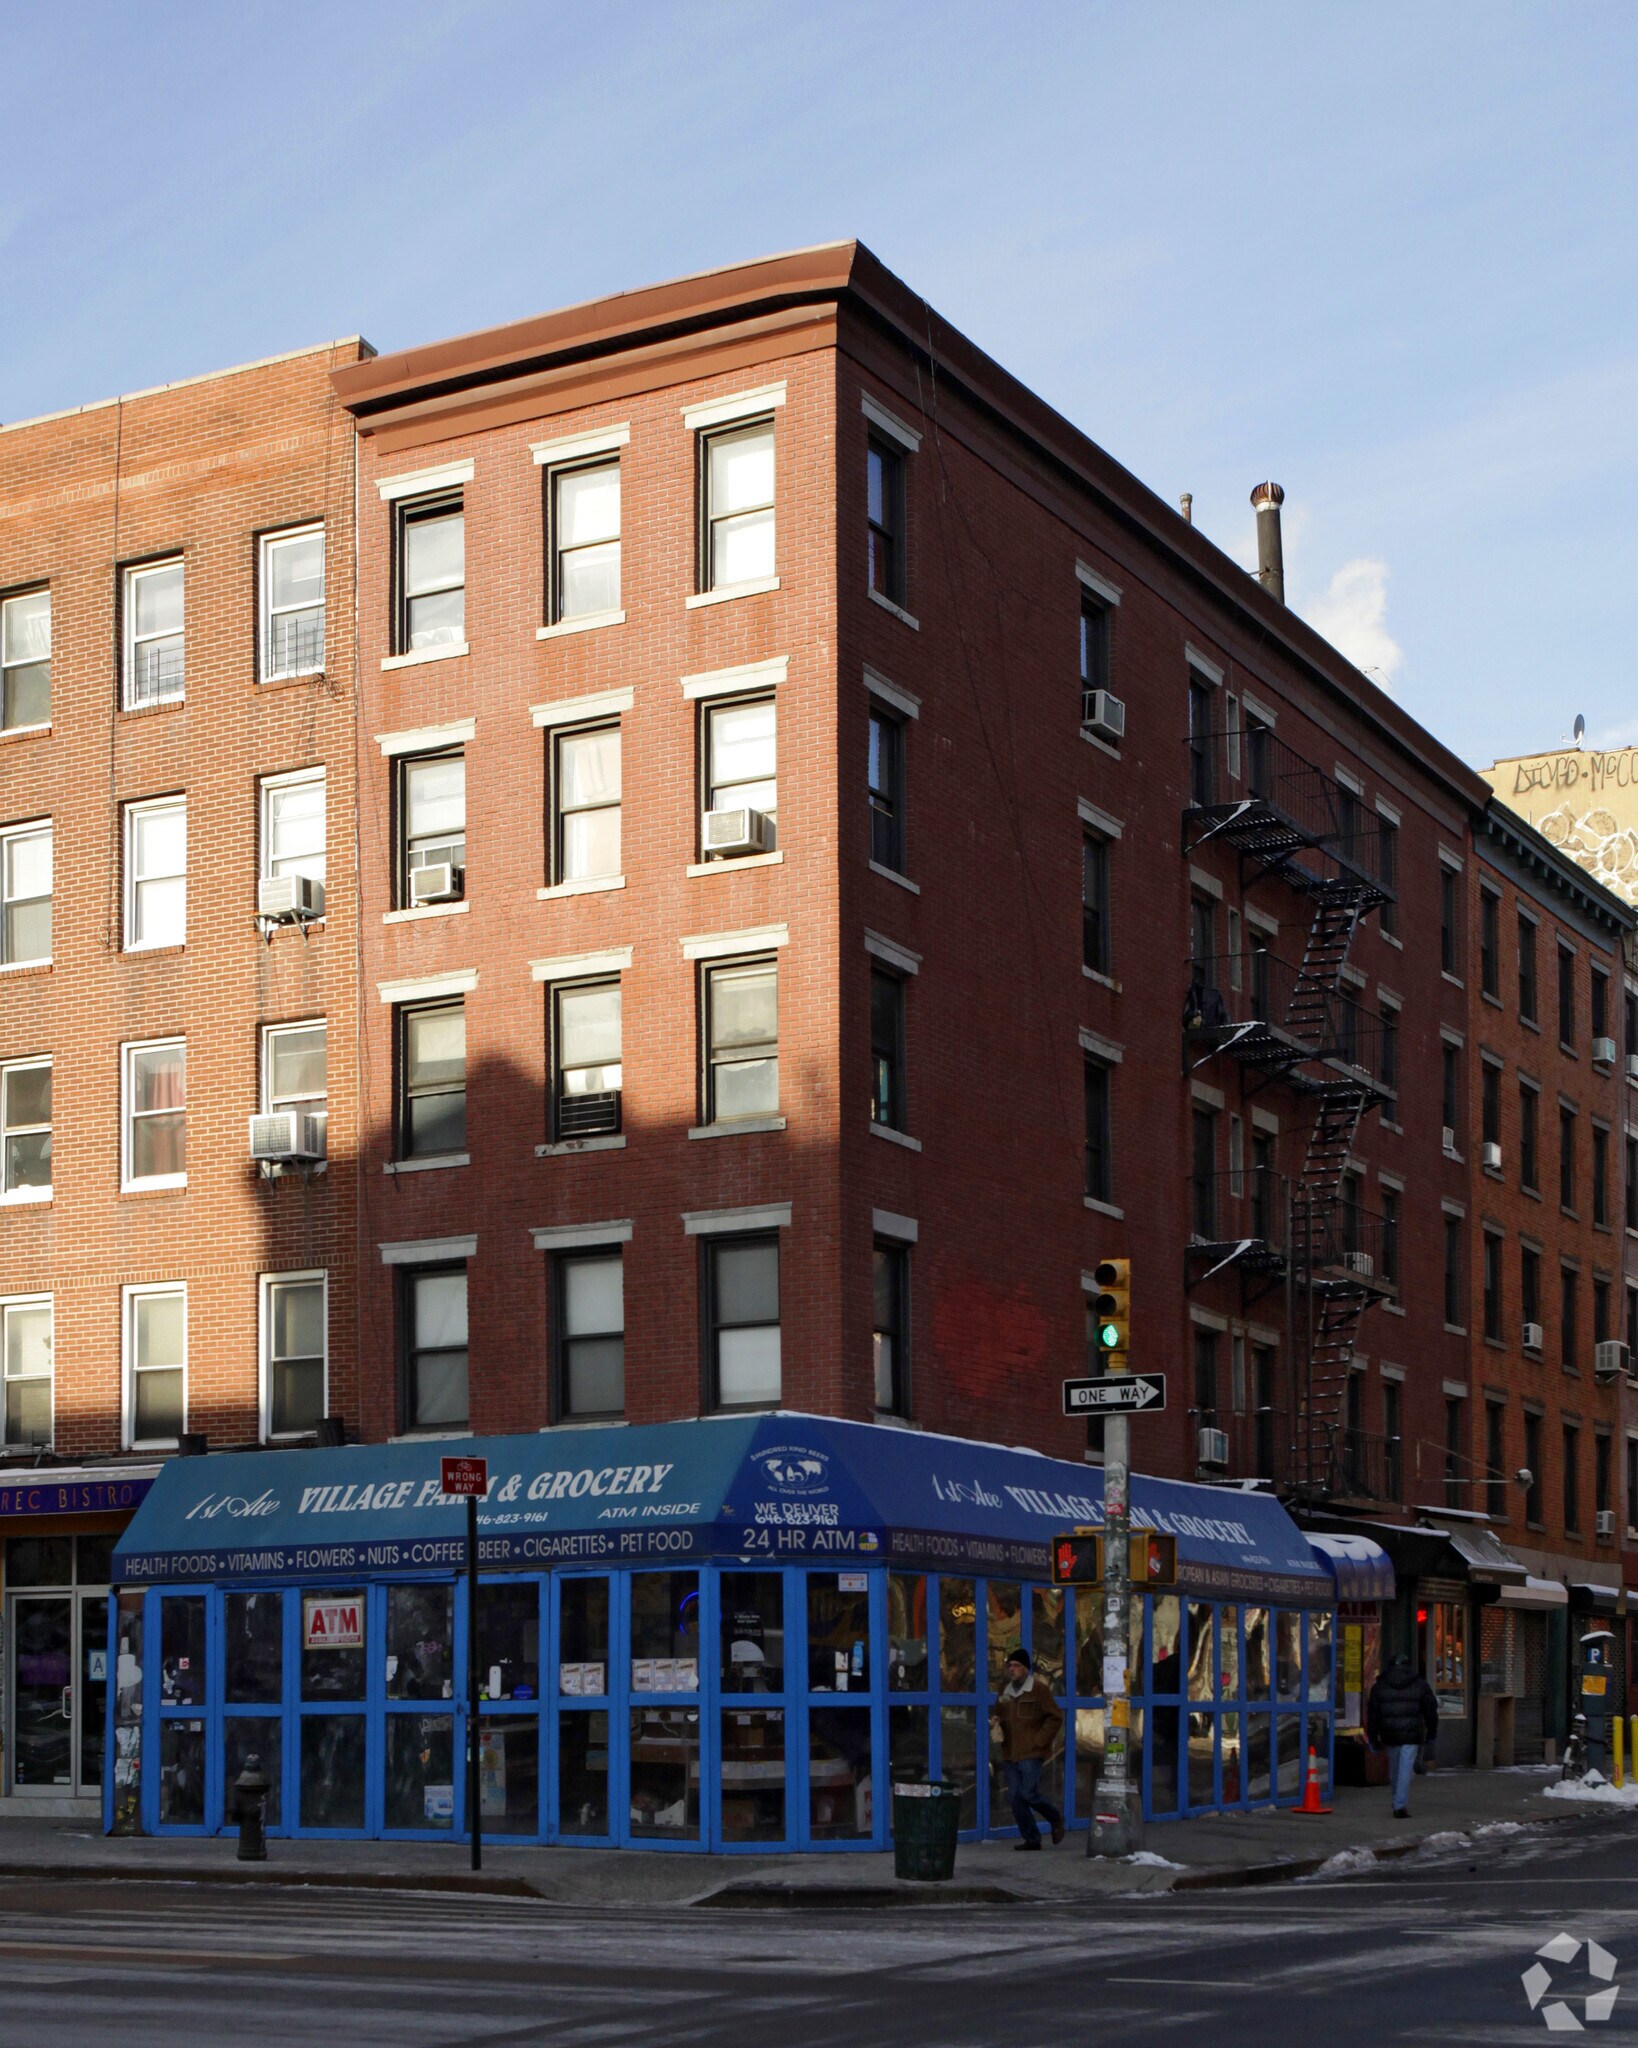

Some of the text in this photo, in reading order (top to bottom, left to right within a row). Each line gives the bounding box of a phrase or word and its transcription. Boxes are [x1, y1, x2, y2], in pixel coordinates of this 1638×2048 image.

[1079, 1386, 1149, 1403] ONE WAY
[447, 1471, 482, 1482] WRONG
[185, 1493, 228, 1519] 1st
[227, 1489, 280, 1517] Ave
[298, 1481, 415, 1514] VILLAGE
[497, 1474, 522, 1503] &
[527, 1463, 674, 1502] GROCERY
[455, 1482, 475, 1492] WAY
[59, 1485, 133, 1508] BISTRO
[598, 1502, 701, 1519] ATM INSIDE
[754, 1502, 839, 1515] WE DELIVER
[932, 1473, 960, 1502] 1st
[957, 1480, 1003, 1509] Ave
[1004, 1485, 1104, 1522] VILLAGE
[1152, 1509, 1177, 1533] &
[1168, 1512, 1256, 1546] GROCERY
[475, 1511, 549, 1525] 46-823-9161
[755, 1513, 838, 1525] 646-823-9161
[743, 1528, 770, 1548] 24
[778, 1529, 806, 1549] HR
[812, 1529, 855, 1549] ATM
[126, 1530, 693, 1576] HEALTH FOODS VITAMINS FLOWERS NUTS COFFEE BEER CIGARETTES PET FOOD
[892, 1533, 923, 1552] HEALTH
[926, 1536, 958, 1556] FOODS
[966, 1540, 1004, 1561] VITAMINS
[1010, 1545, 1047, 1566] FLOWERS
[1336, 1601, 1377, 1616] ATM
[311, 1608, 358, 1634] ATM
[1591, 1648, 1600, 1662] P
[93, 1656, 103, 1672] A
